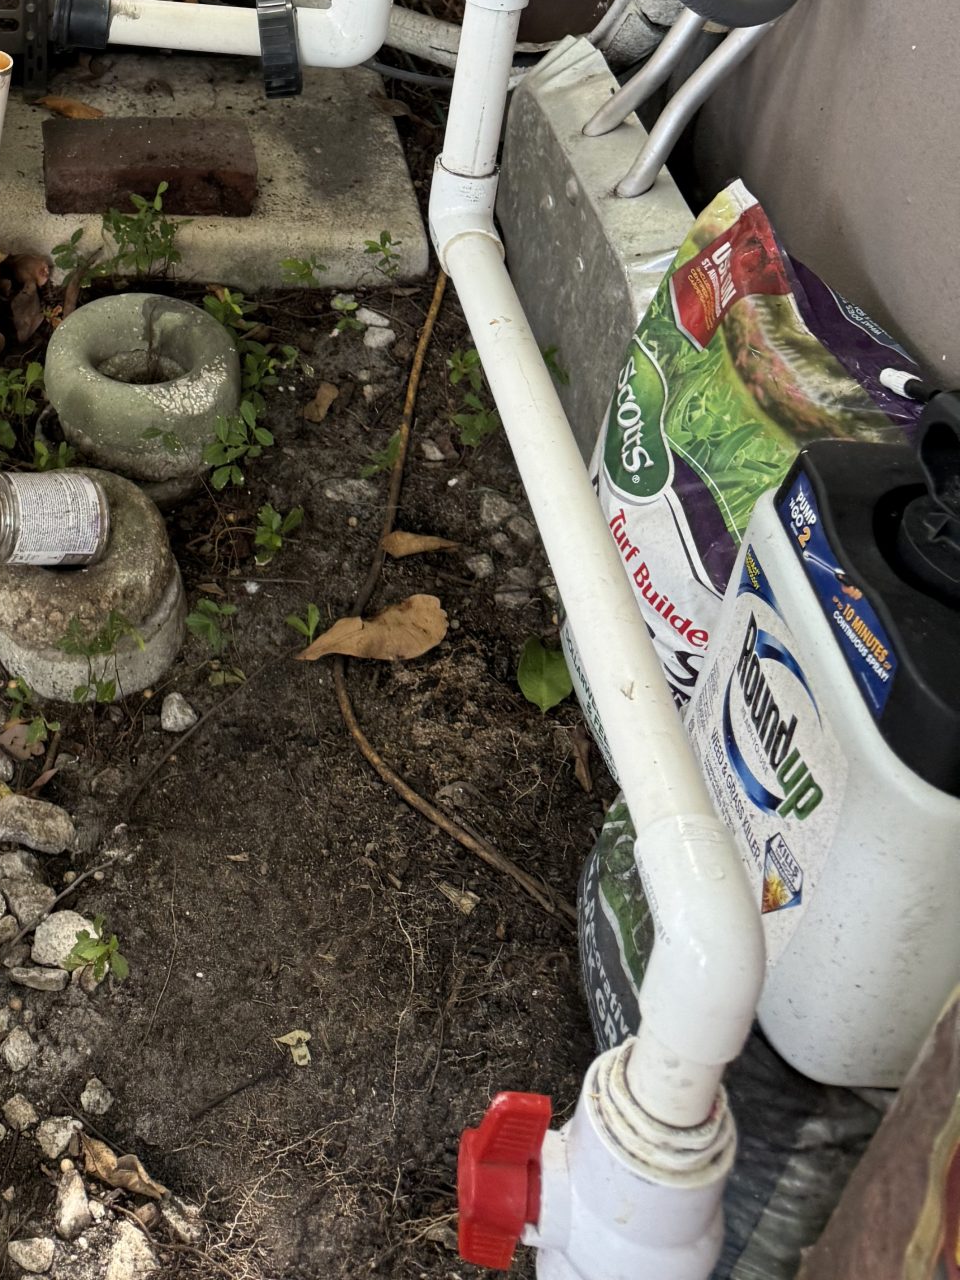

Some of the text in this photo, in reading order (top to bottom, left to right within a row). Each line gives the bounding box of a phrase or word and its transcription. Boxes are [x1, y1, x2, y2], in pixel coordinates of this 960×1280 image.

[845, 305, 863, 322] DOES
[617, 356, 654, 473] Scotts
[796, 492, 817, 526] PUMP
[797, 526, 812, 548] 2
[609, 508, 641, 563] Turf
[633, 562, 710, 651] Builde
[833, 610, 890, 682] CONTINUOUS SPRAY!
[842, 603, 855, 622] 10
[851, 616, 890, 662] MINUTES
[737, 610, 824, 822] Roundup
[710, 727, 723, 765] WEED
[723, 775, 746, 820] GRASS
[741, 817, 762, 863] KILLER
[777, 840, 800, 877] KILLS
[582, 897, 631, 1037] Decorativ
